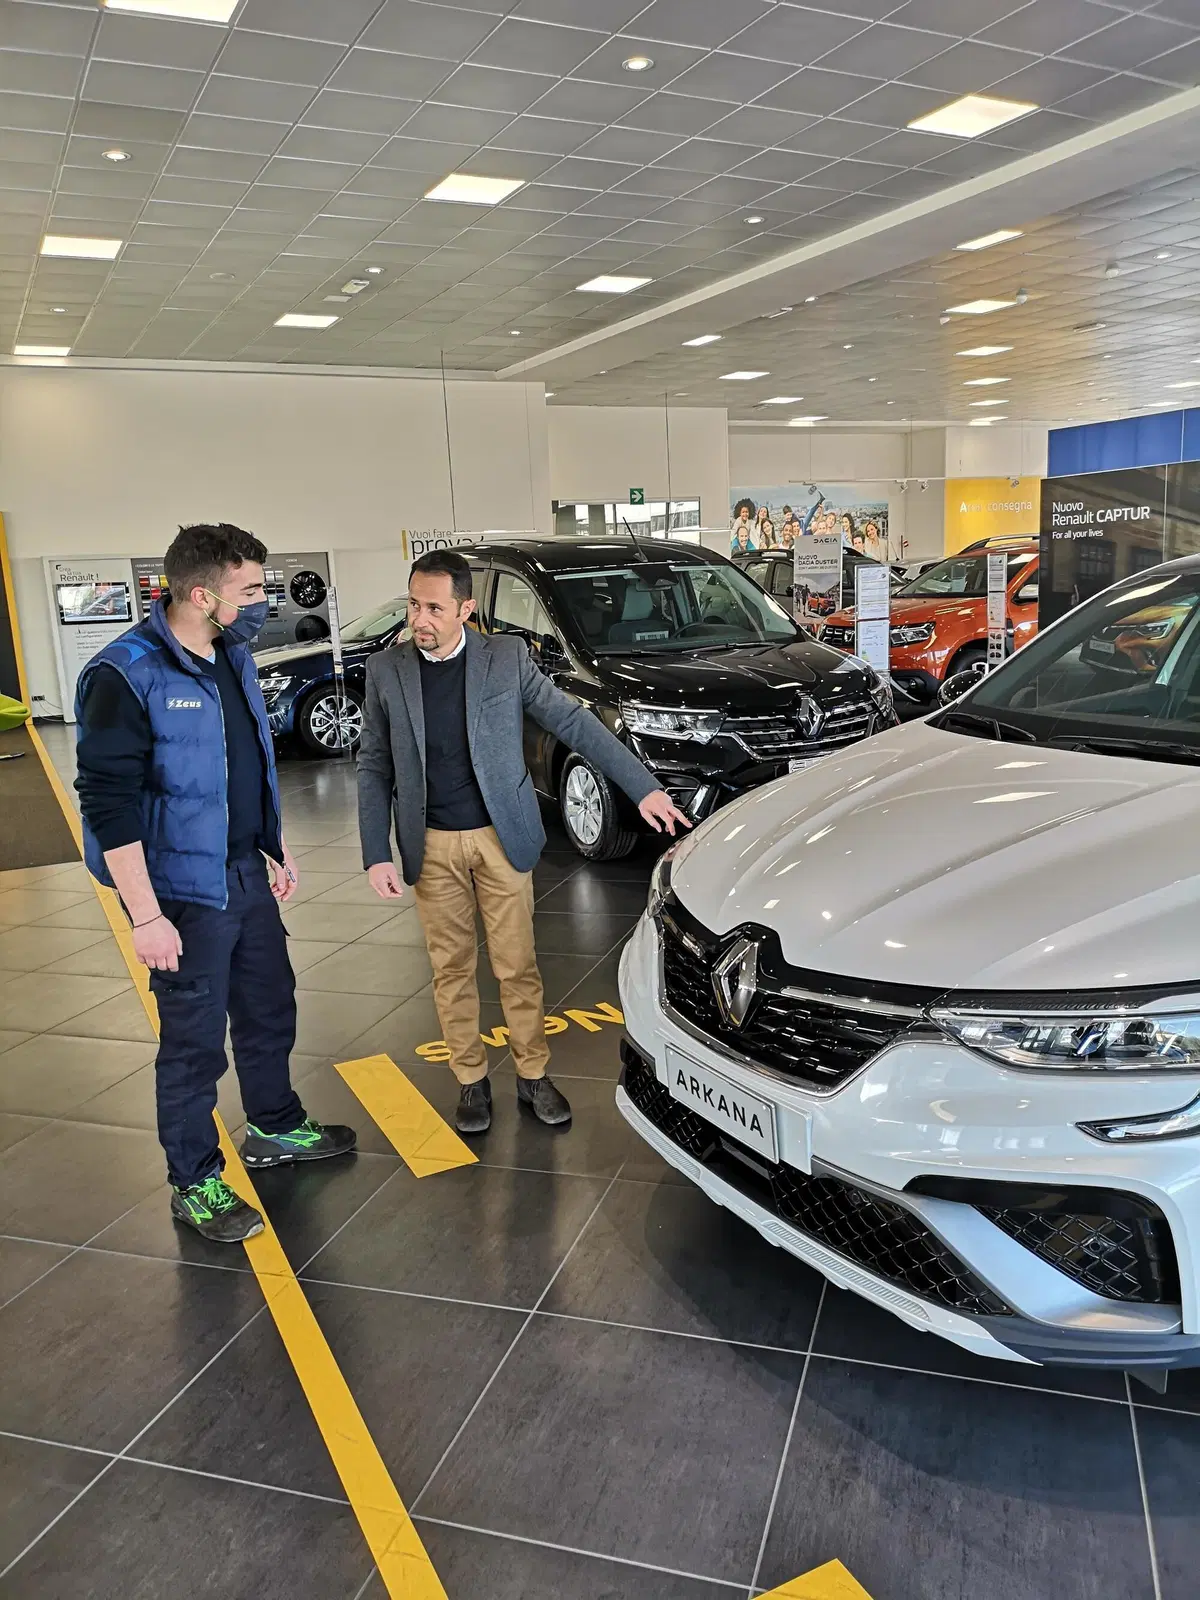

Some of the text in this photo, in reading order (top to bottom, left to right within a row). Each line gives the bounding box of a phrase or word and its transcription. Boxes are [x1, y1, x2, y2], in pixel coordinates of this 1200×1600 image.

[987, 501, 1032, 512] consegna
[1052, 501, 1083, 513] Nuovo
[1052, 506, 1151, 526] Renault CAPTUR
[408, 528, 452, 539] Vuoi fare
[1052, 528, 1104, 541] For all your lives
[60, 573, 95, 582] Renault
[175, 699, 202, 708] Zeus
[676, 1069, 764, 1138] ARKANA
